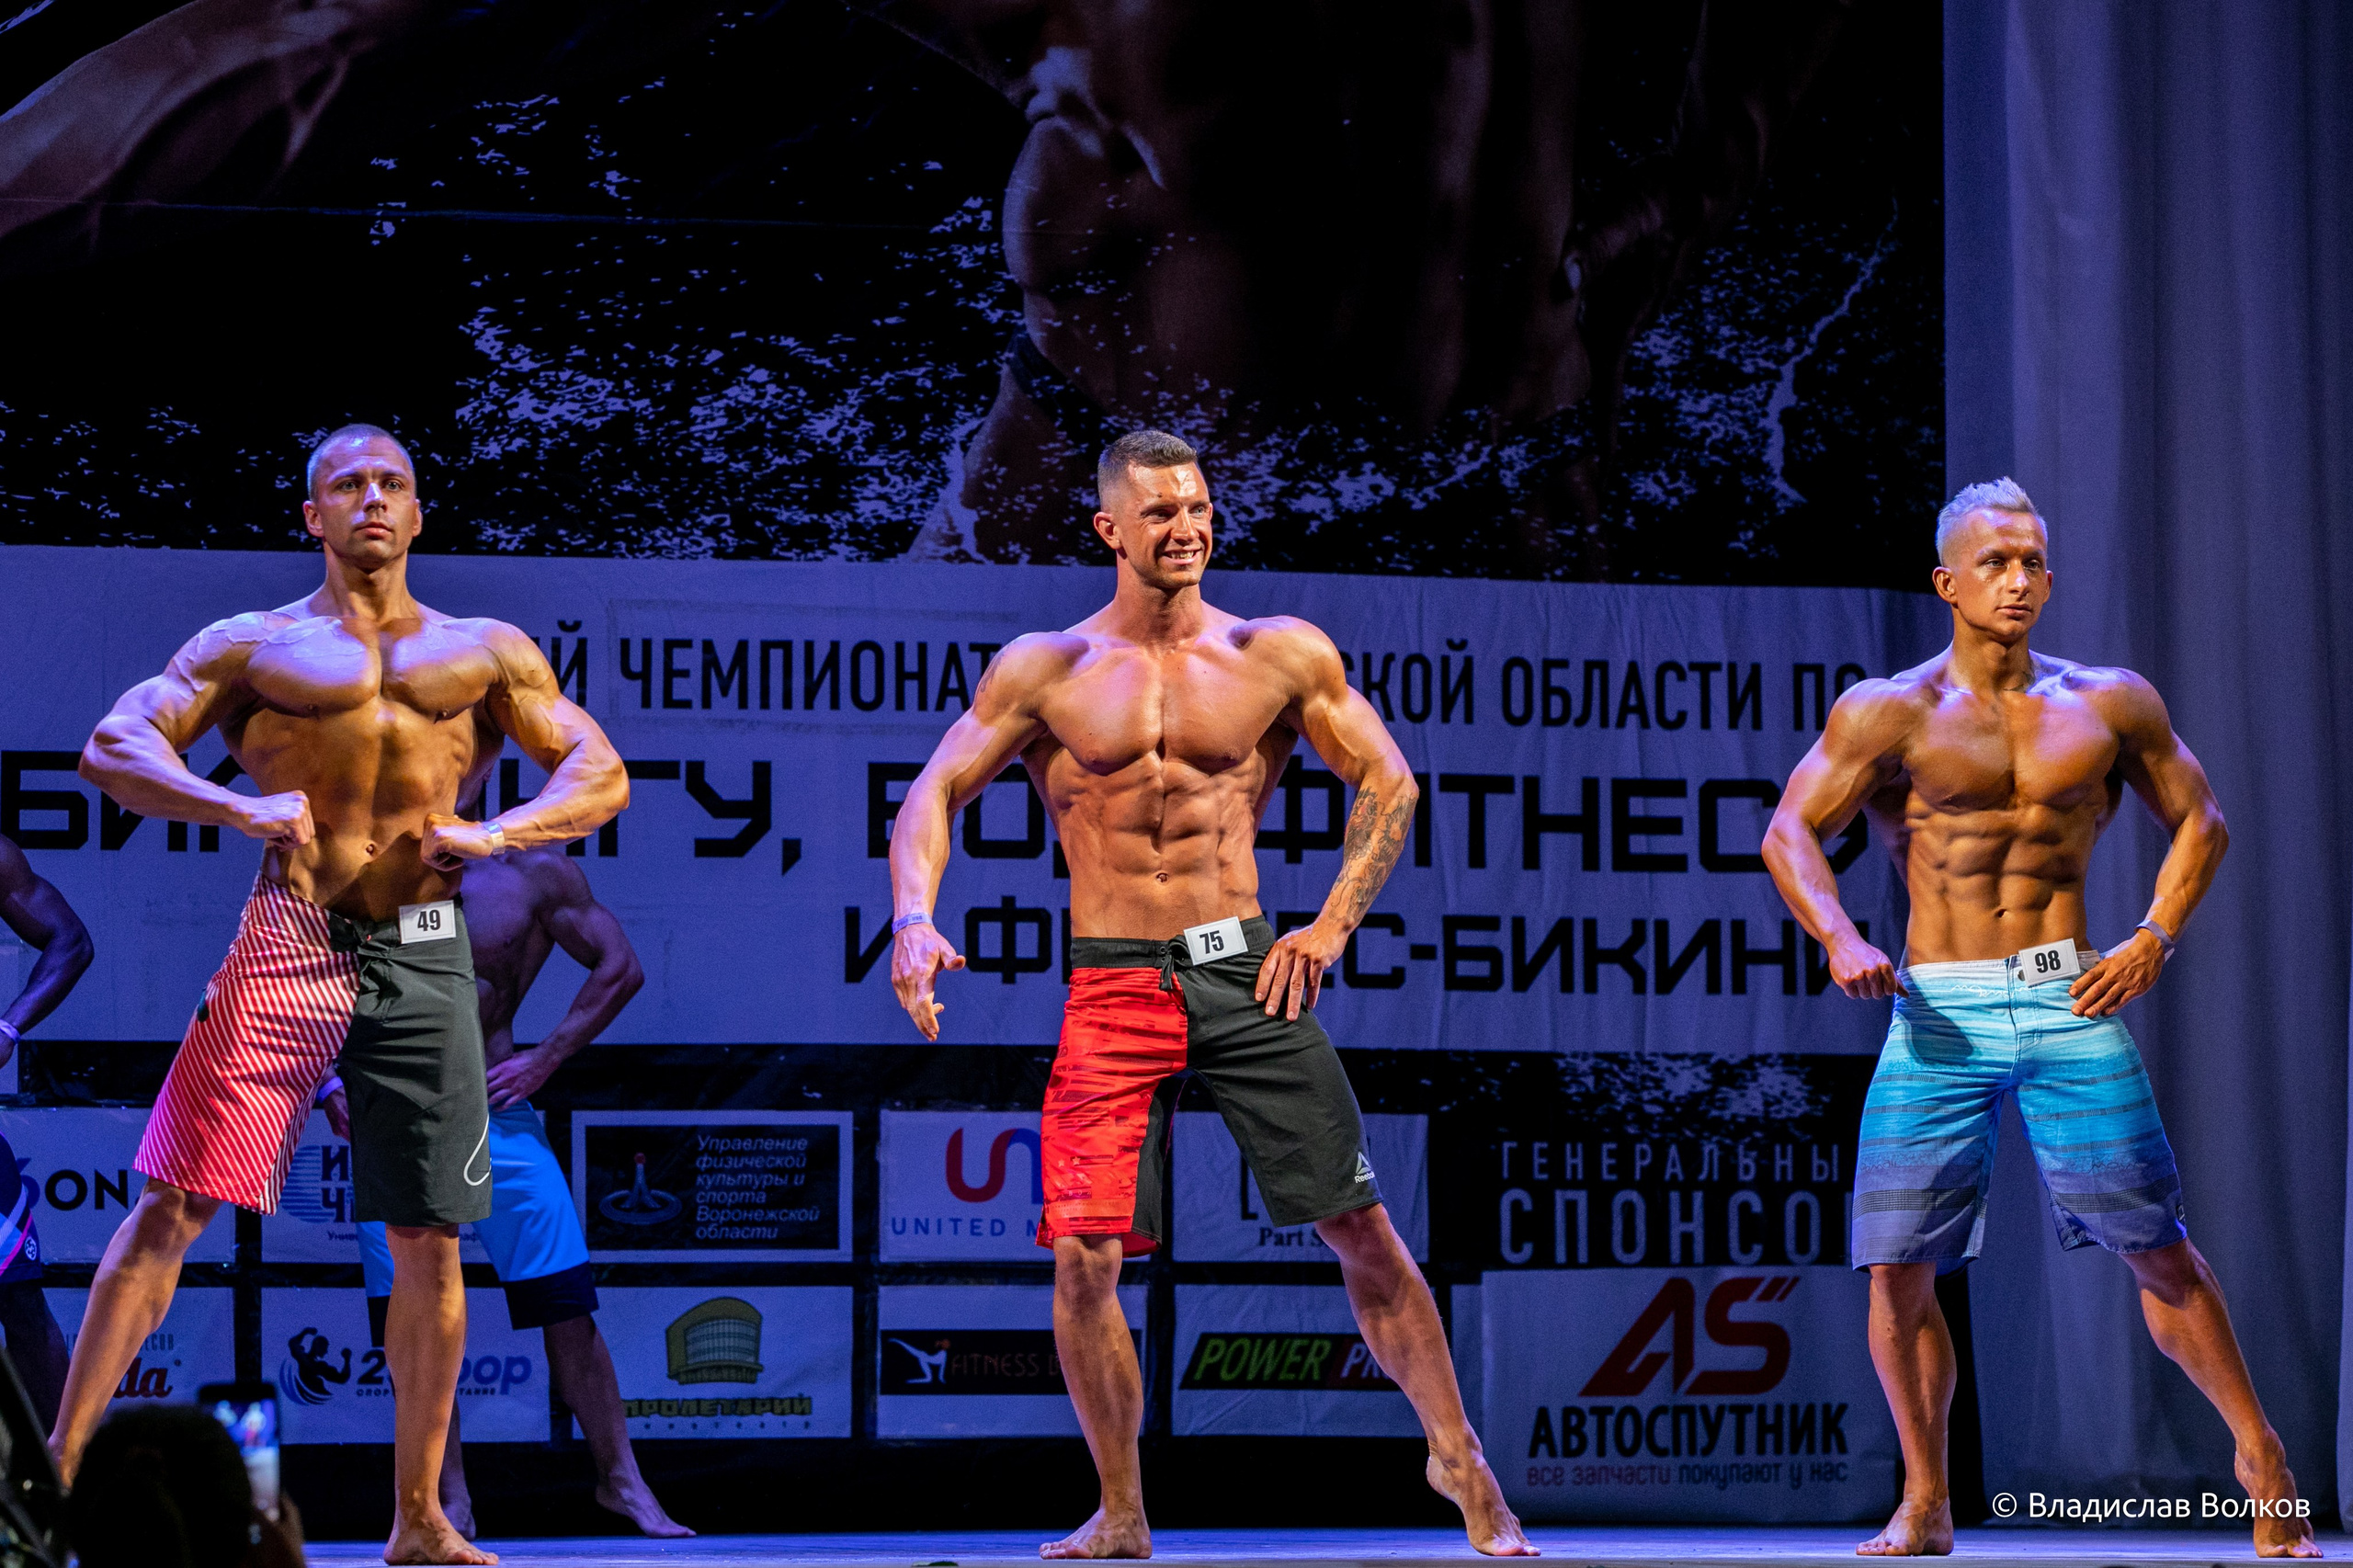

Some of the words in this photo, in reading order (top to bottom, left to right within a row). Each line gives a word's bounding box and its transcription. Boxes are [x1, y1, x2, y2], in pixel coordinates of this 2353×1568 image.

[1501, 655, 1763, 732] ОБЛАСТИ
[417, 909, 441, 932] 49
[1199, 929, 1225, 955] 75
[2034, 949, 2062, 973] 98
[698, 1135, 808, 1153] Управление
[696, 1153, 806, 1171] физической
[696, 1174, 790, 1189] культуры
[793, 1174, 805, 1186] и
[696, 1191, 767, 1207] спорта
[697, 1206, 820, 1224] Воронежской
[1499, 1188, 1854, 1265] СПОНСО
[695, 1223, 779, 1239] области
[892, 1218, 1006, 1236] UNITED
[1258, 1227, 1304, 1246] Part
[950, 1354, 1040, 1377] FITNESS
[1195, 1338, 1332, 1381] POWER
[1528, 1403, 1849, 1459] АВТОСПУТНИК
[1527, 1467, 1564, 1487] все
[1571, 1465, 1671, 1486] запчасти
[1677, 1464, 1781, 1491] покупают
